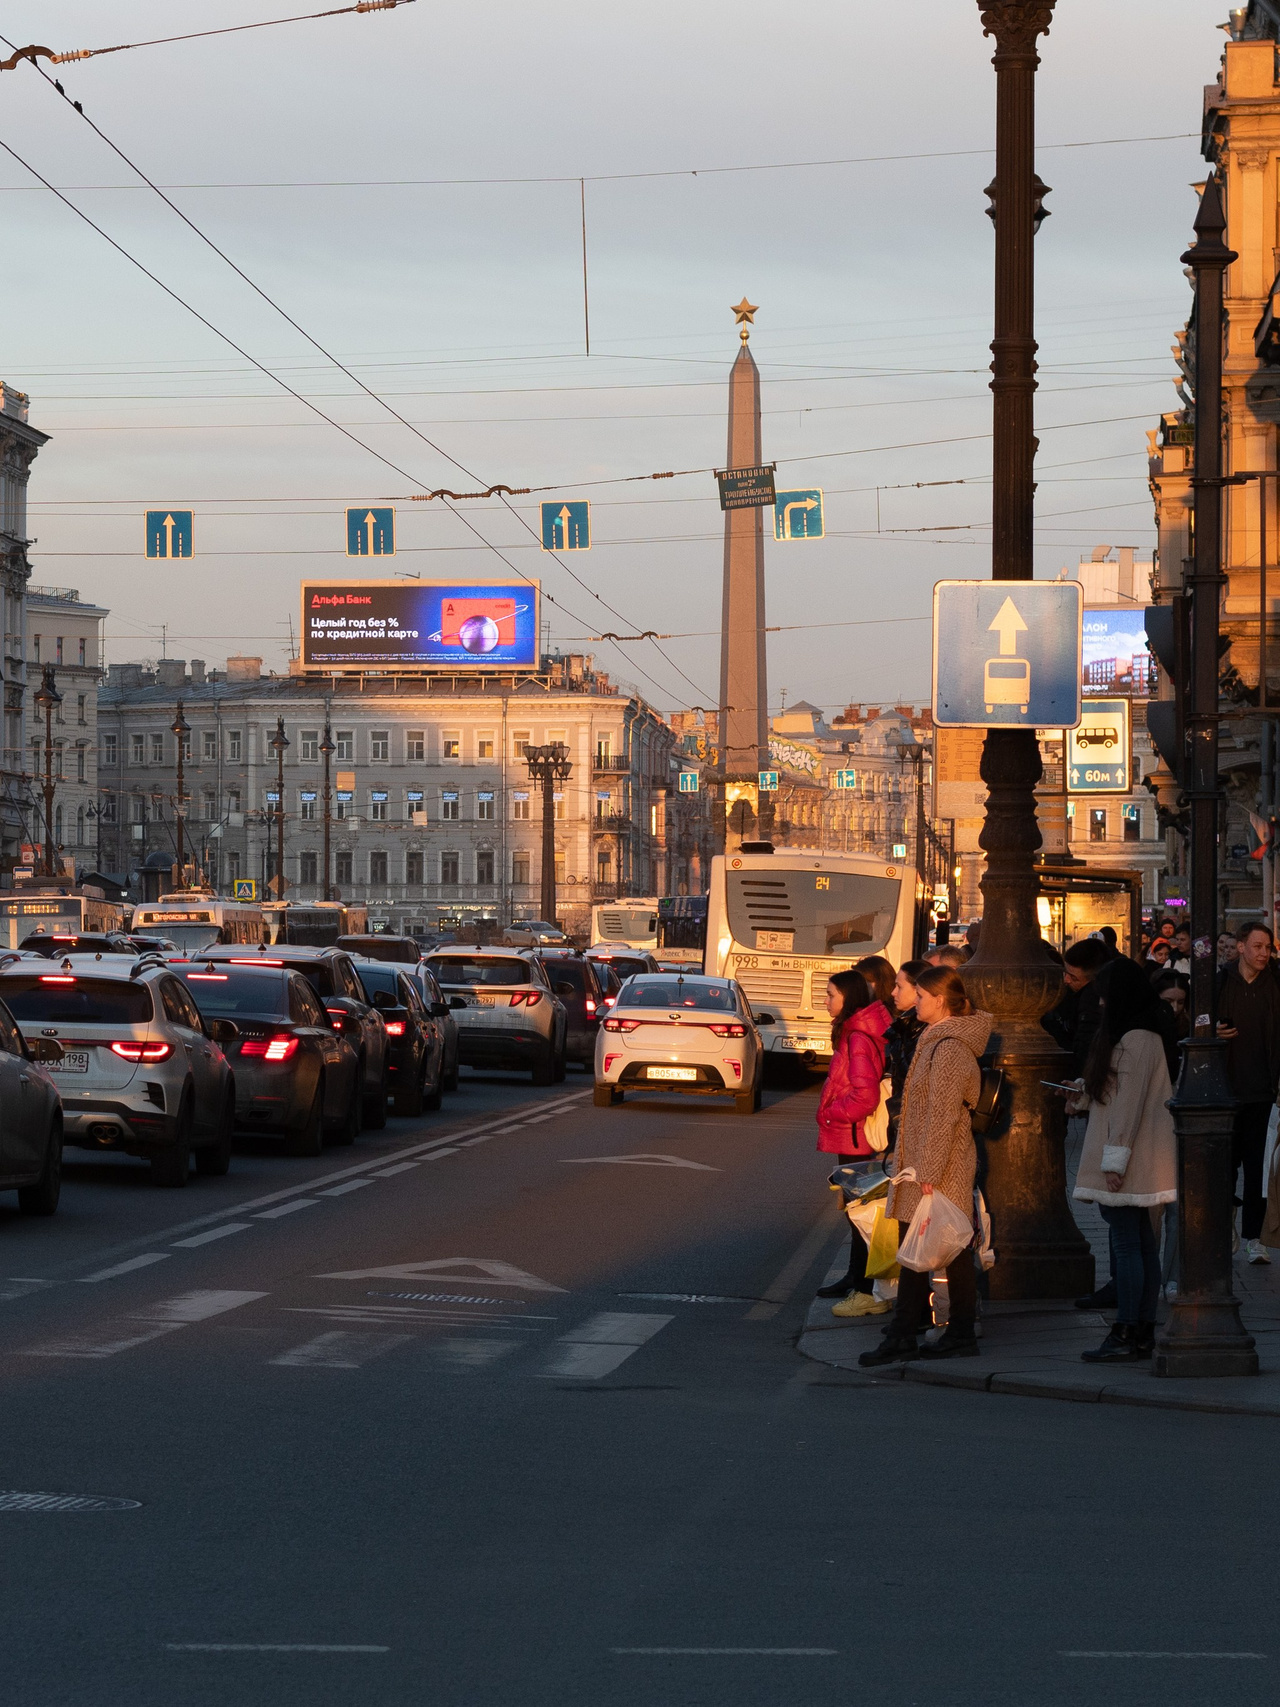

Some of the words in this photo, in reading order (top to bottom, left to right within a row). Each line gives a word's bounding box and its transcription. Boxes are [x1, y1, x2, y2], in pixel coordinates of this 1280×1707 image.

[722, 467, 770, 480] ОСТАНОВКА
[311, 594, 345, 606] Альфа
[346, 594, 372, 605] Банк
[311, 617, 347, 629] Целый
[348, 619, 366, 629] год
[367, 617, 386, 628] без
[387, 617, 399, 628] %
[311, 630, 325, 638] по
[326, 628, 387, 639] кредитной
[389, 630, 420, 640] карте
[1084, 770, 1111, 782] 60м
[815, 877, 829, 890] 24
[731, 955, 758, 968] 1998
[781, 959, 790, 967] 1м
[793, 960, 826, 970] ВЫНОС
[66, 1054, 84, 1064] 198
